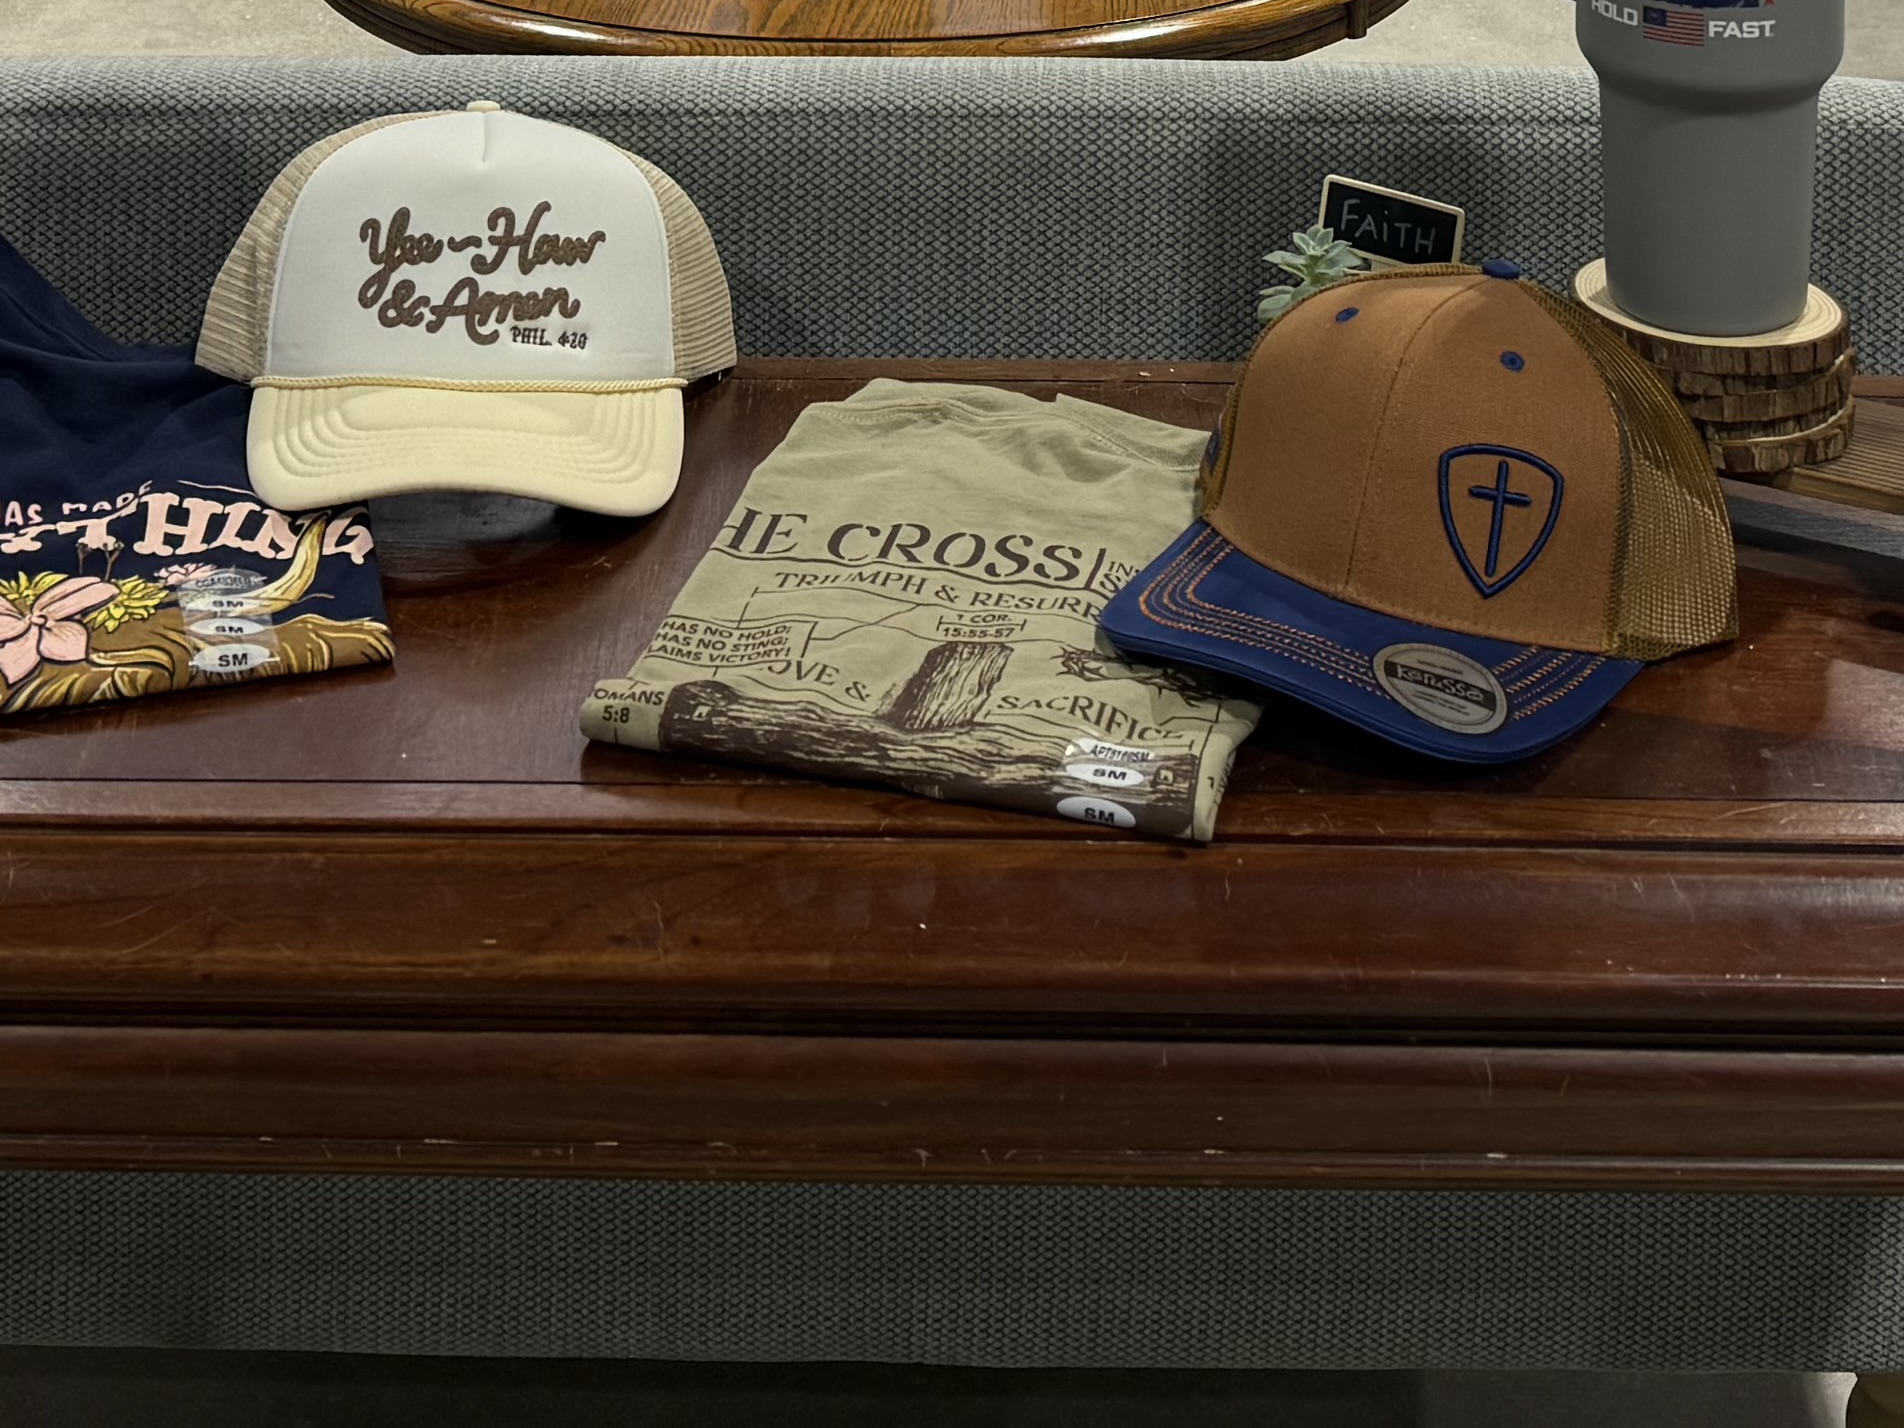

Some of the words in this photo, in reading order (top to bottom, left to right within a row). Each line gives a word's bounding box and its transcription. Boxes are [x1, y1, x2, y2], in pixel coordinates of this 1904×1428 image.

[1708, 20, 1772, 39] FAST
[425, 273, 582, 347] Amen
[510, 325, 553, 348] PHIL.
[827, 522, 1084, 584] CROSS
[774, 570, 925, 598] TRIUMPH
[934, 584, 960, 604] &
[660, 619, 699, 636] HAS
[703, 623, 733, 639] NO
[969, 613, 1013, 625] COR.
[654, 631, 692, 648] HAS
[696, 636, 727, 653] NO
[942, 626, 1016, 640] 15:55-57
[215, 647, 250, 671] SM
[708, 646, 792, 665] VICTORY!
[844, 679, 871, 702] &
[1386, 660, 1487, 705] Kerusso
[602, 705, 631, 725] 5:8
[1092, 767, 1128, 781] SM
[1083, 806, 1117, 824] SM
